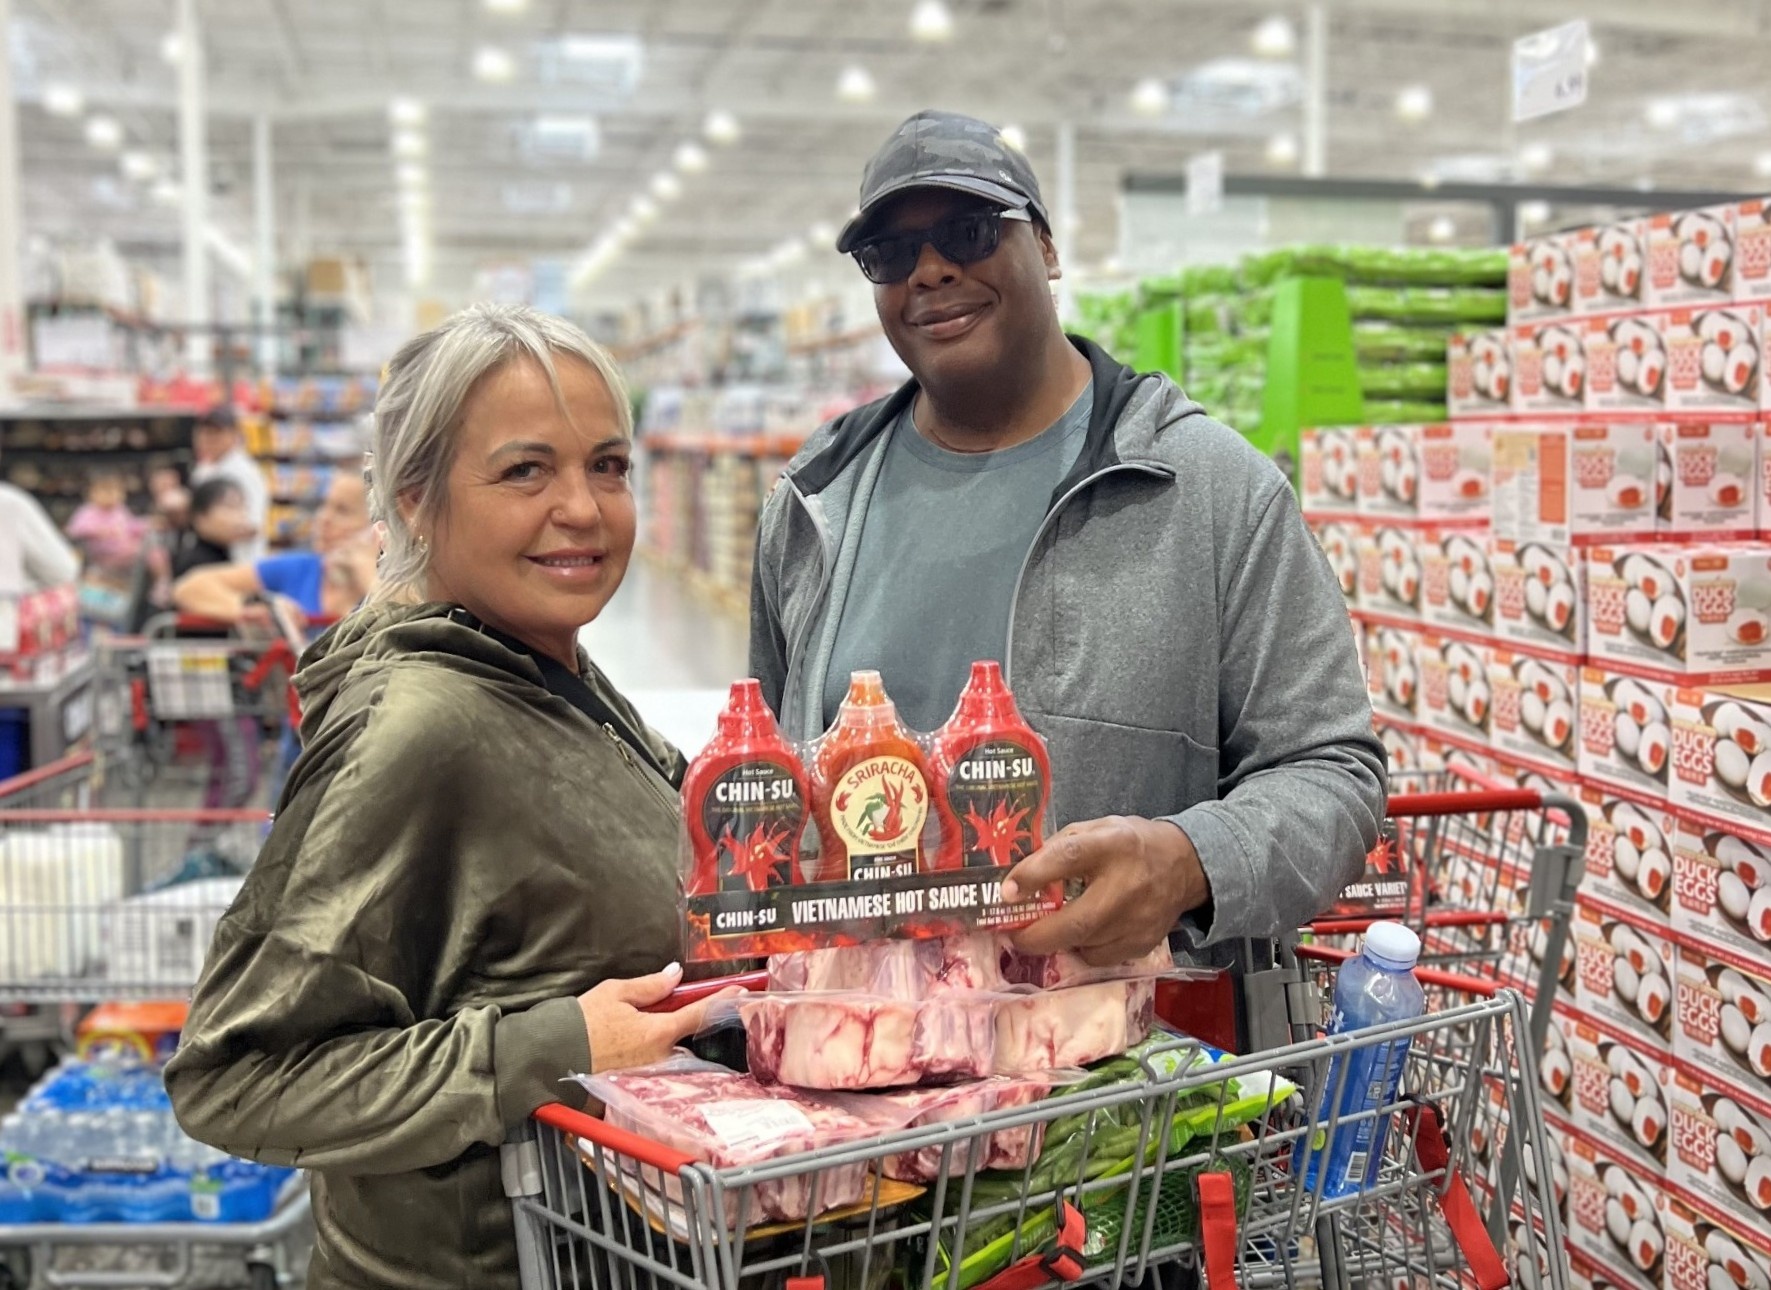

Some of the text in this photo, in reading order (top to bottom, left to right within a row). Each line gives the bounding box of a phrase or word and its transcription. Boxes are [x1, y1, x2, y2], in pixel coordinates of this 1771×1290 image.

[1692, 586, 1734, 601] DUCK
[1694, 599, 1733, 615] EGGS
[1671, 728, 1715, 756] DUCK
[960, 757, 1033, 780] CHIN-SU
[1673, 746, 1713, 775] EGGS
[715, 778, 794, 802] CHIN-SU
[847, 761, 916, 790] SRIRACHA
[853, 862, 912, 881] CHIN-SU
[1673, 855, 1719, 886] DUCK
[1344, 883, 1374, 899] SAUCE
[1675, 875, 1716, 905] EGGS
[716, 907, 777, 929] CHIN-SU
[792, 893, 891, 924] VIETNAMESE
[895, 889, 925, 912] HOT
[929, 883, 977, 910] SAUCE
[1578, 942, 1615, 968] DUCK
[1579, 958, 1613, 988] EGGS
[1677, 984, 1721, 1017] DUCK
[1679, 1003, 1718, 1034] EGGS
[1671, 1111, 1717, 1145] DUCK
[1672, 1130, 1714, 1163] EGGS
[1665, 1235, 1707, 1271] DUCK
[1666, 1254, 1705, 1290] EGGS
